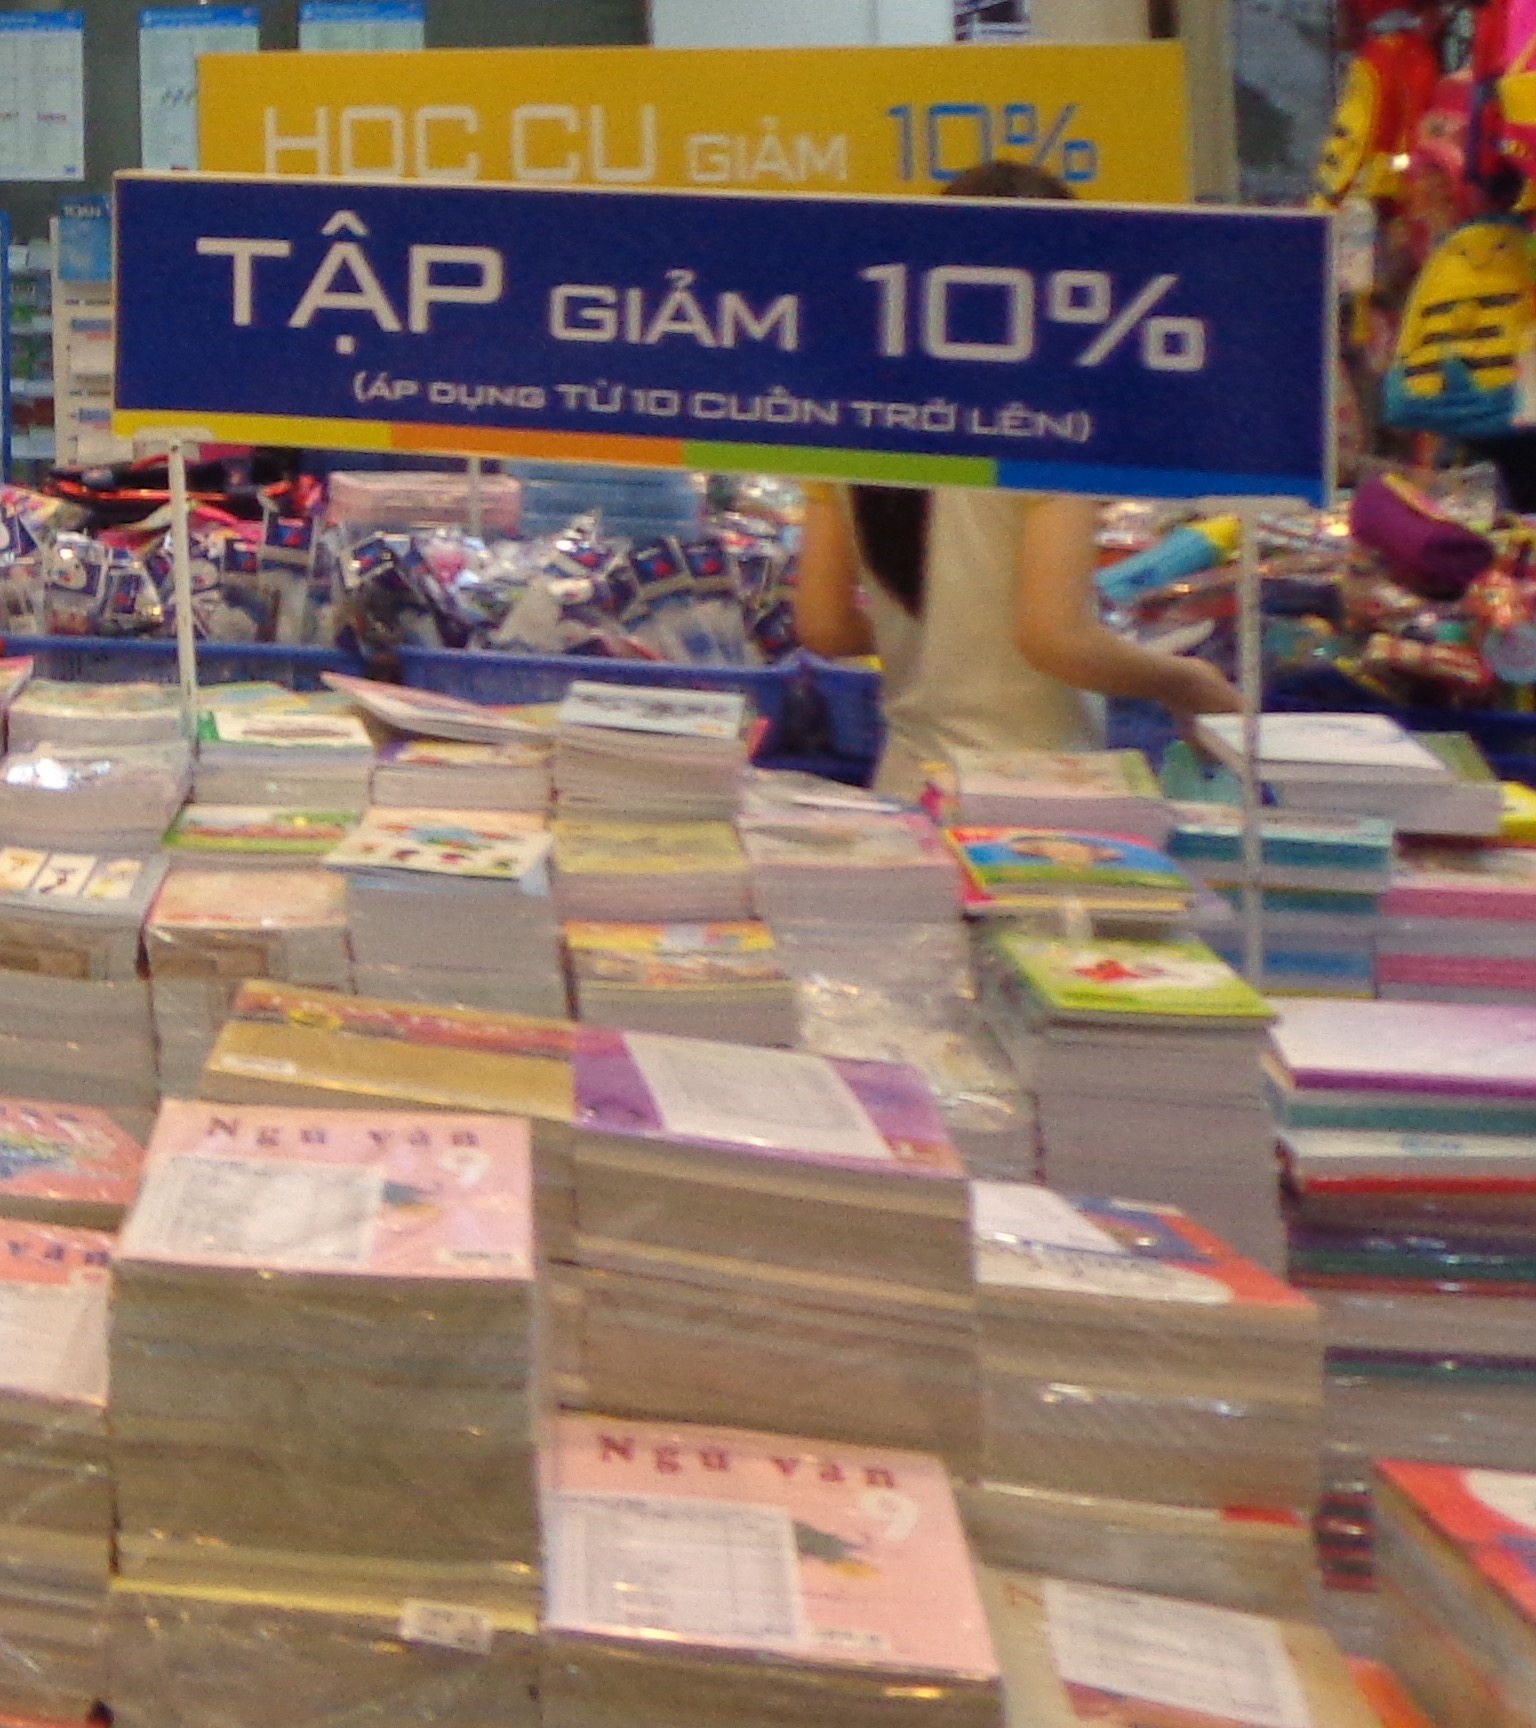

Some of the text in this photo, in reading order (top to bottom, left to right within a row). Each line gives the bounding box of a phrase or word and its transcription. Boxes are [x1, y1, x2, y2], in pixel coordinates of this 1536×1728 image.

[684, 116, 849, 184] GIẢM
[887, 102, 1100, 183] 10%
[195, 209, 1208, 374] TẬP GIẢM 10%
[352, 372, 421, 405] (ÁP
[429, 379, 548, 413] DỤNG
[629, 387, 681, 418] 10
[970, 399, 1095, 444] LÊN)
